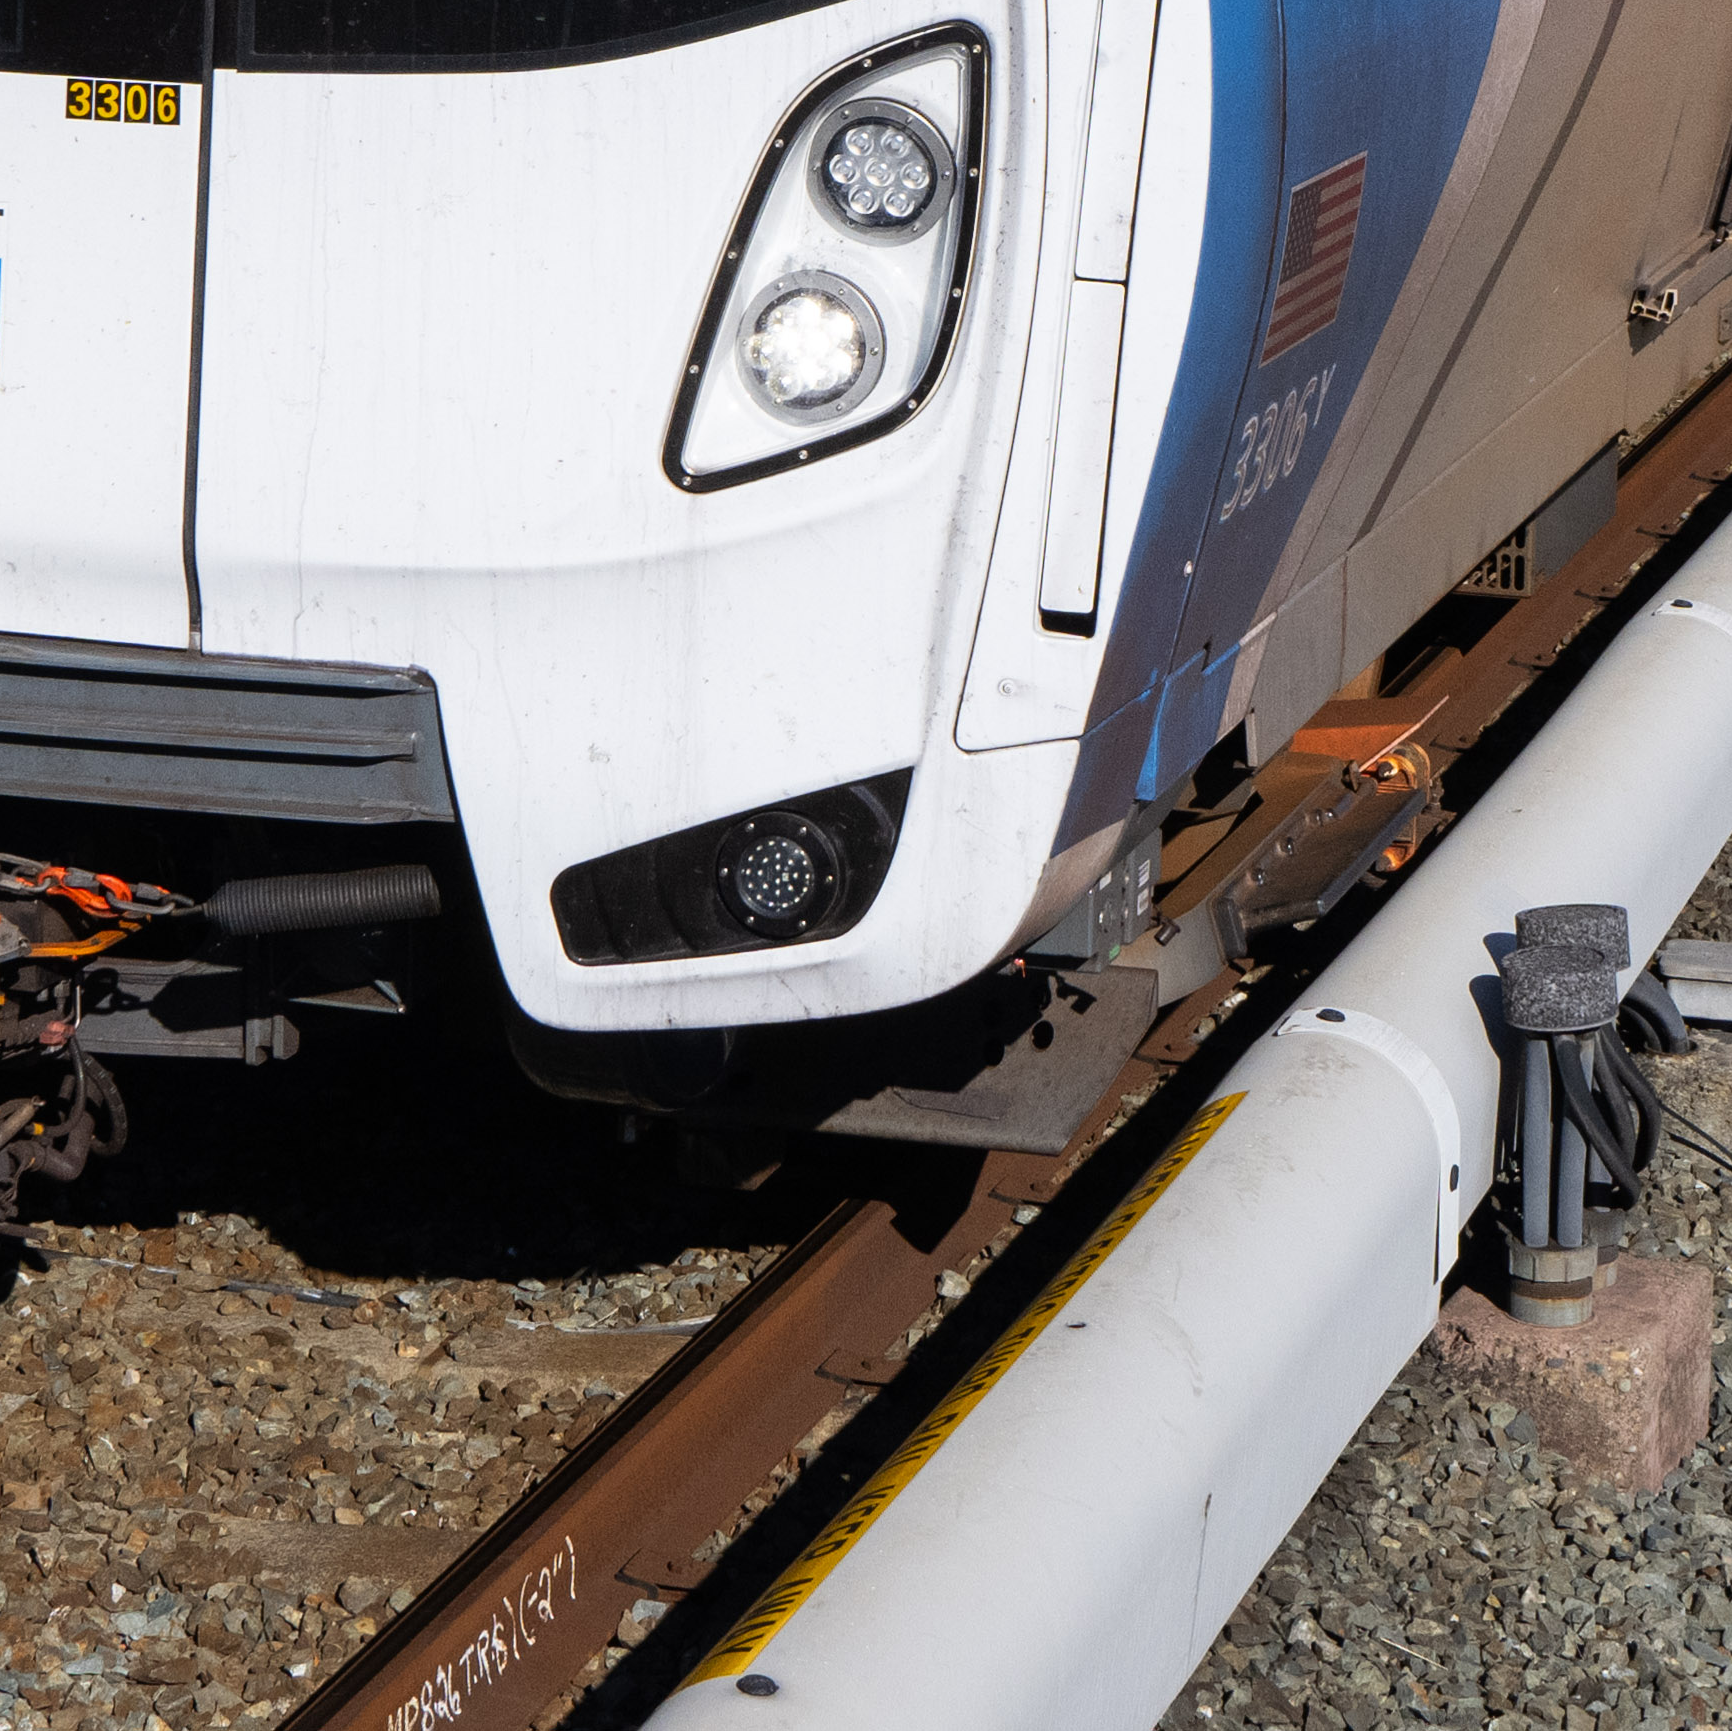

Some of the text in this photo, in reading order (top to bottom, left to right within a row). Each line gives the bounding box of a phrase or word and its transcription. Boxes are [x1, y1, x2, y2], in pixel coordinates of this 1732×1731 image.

[68, 80, 178, 124] 3306
[800, 1484, 895, 1562] KEEP
[706, 1577, 814, 1661] AWAY
